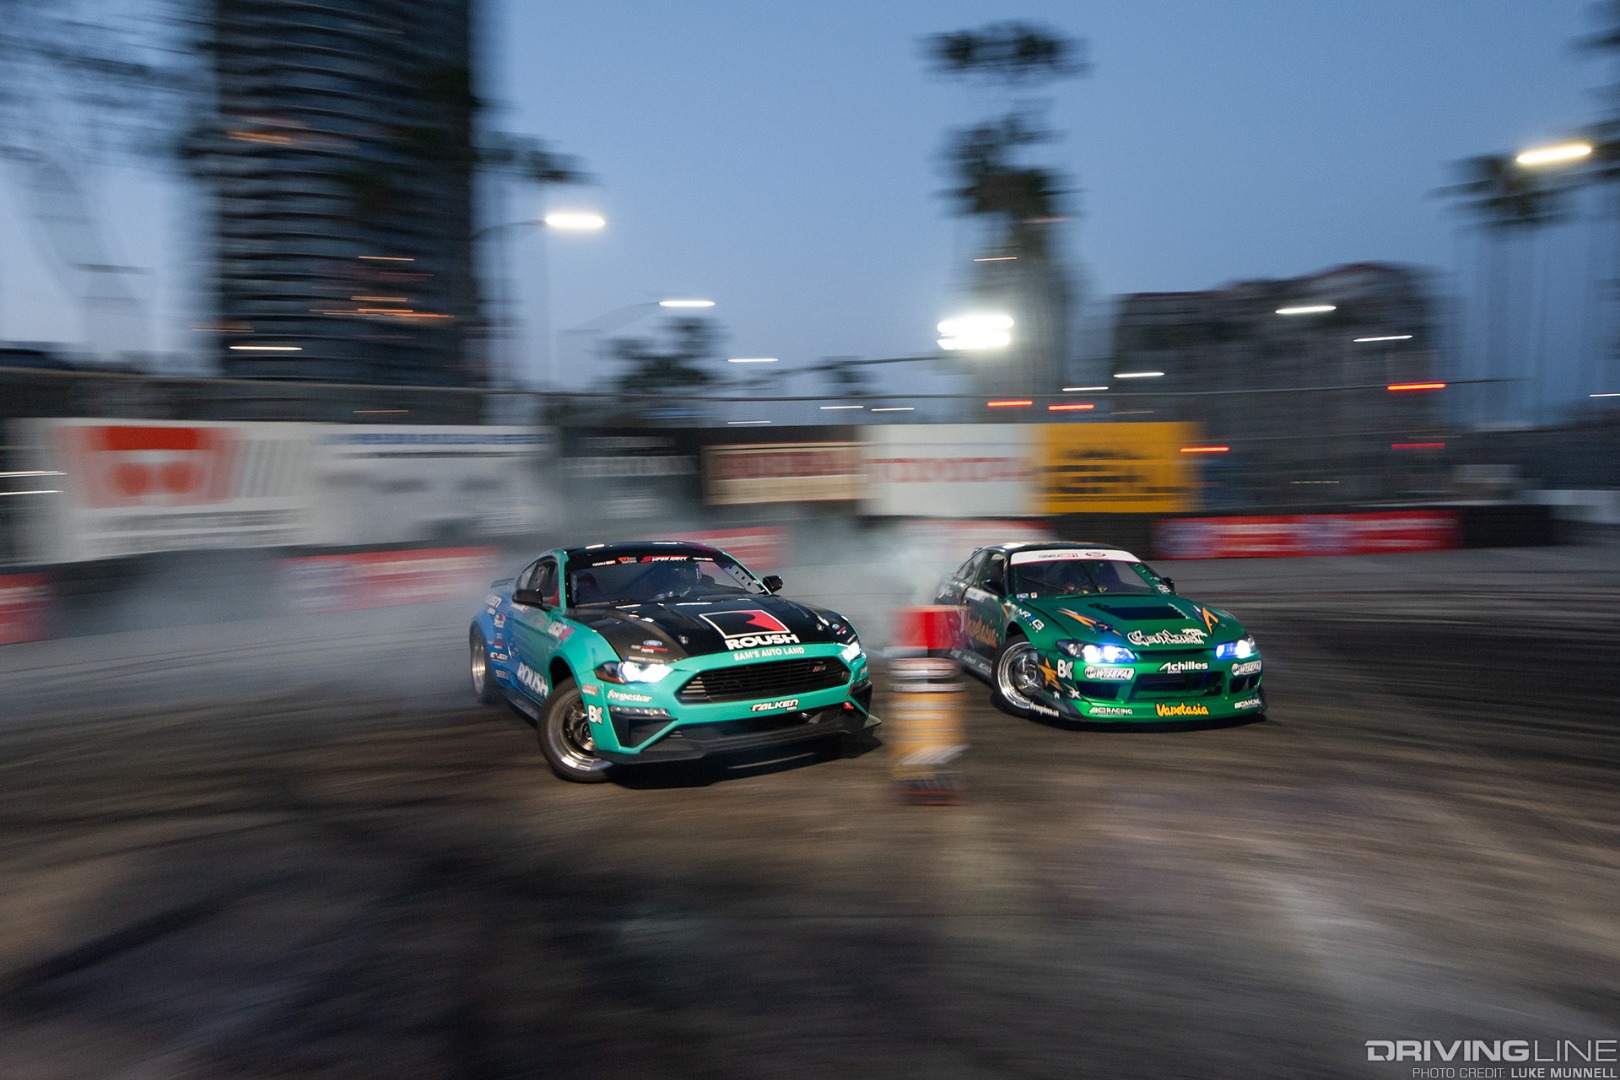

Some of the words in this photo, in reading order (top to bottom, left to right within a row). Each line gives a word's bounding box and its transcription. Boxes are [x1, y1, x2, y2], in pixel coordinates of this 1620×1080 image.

[724, 634, 800, 651] ROUSH
[733, 649, 760, 661] SAM'S
[761, 648, 782, 657] AUTO
[783, 646, 805, 655] LAND
[1159, 661, 1208, 672] Achilles
[516, 661, 550, 700] ROUSH
[1155, 701, 1209, 717] Vapetasia
